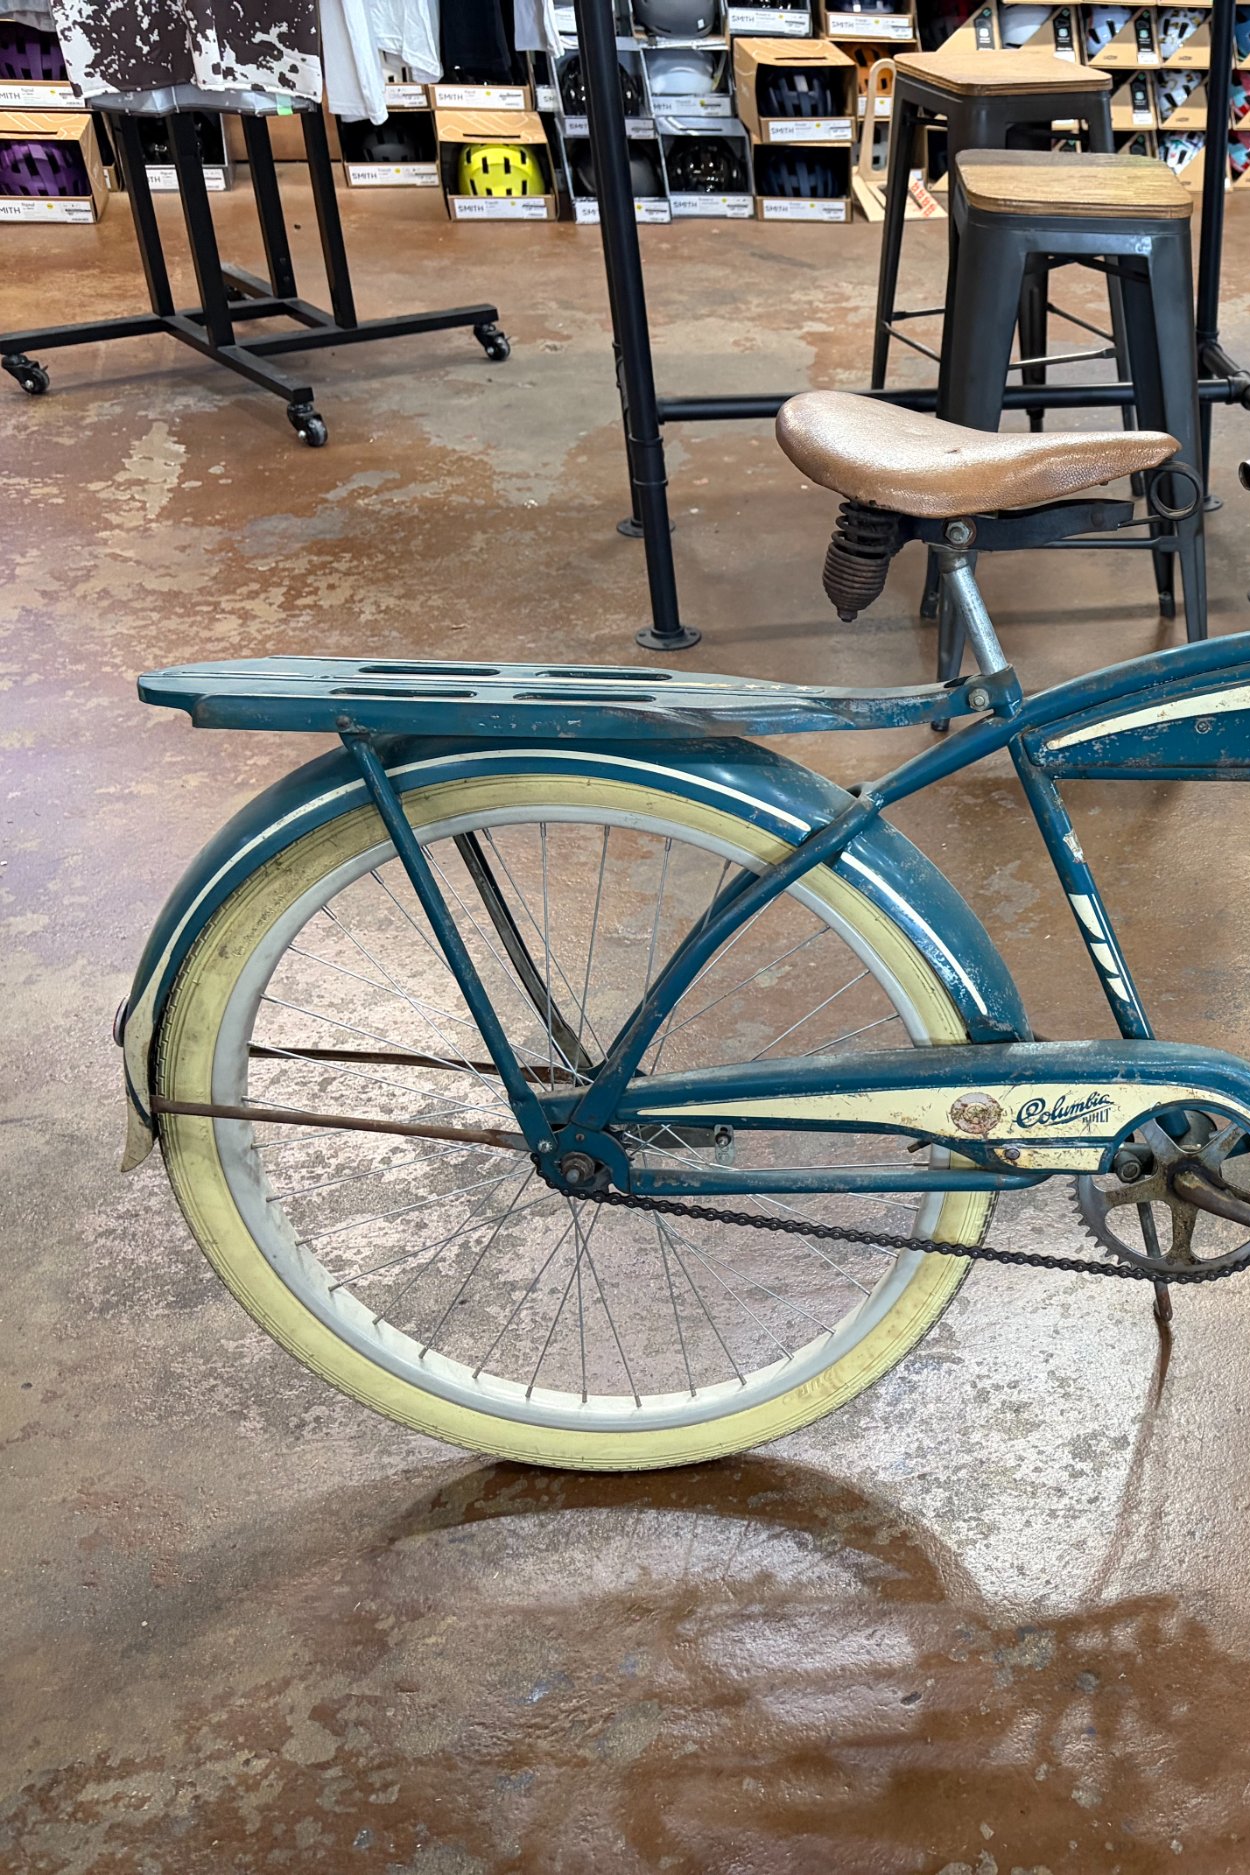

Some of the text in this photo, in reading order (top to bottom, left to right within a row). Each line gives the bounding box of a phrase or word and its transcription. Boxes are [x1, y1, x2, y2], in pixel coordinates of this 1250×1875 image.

[0, 92, 21, 100] MITH
[438, 93, 463, 101] SMITH
[352, 172, 378, 180] SMITH
[0, 206, 21, 214] MITH
[458, 204, 484, 213] SMITH
[1012, 1091, 1114, 1128] Columbia
